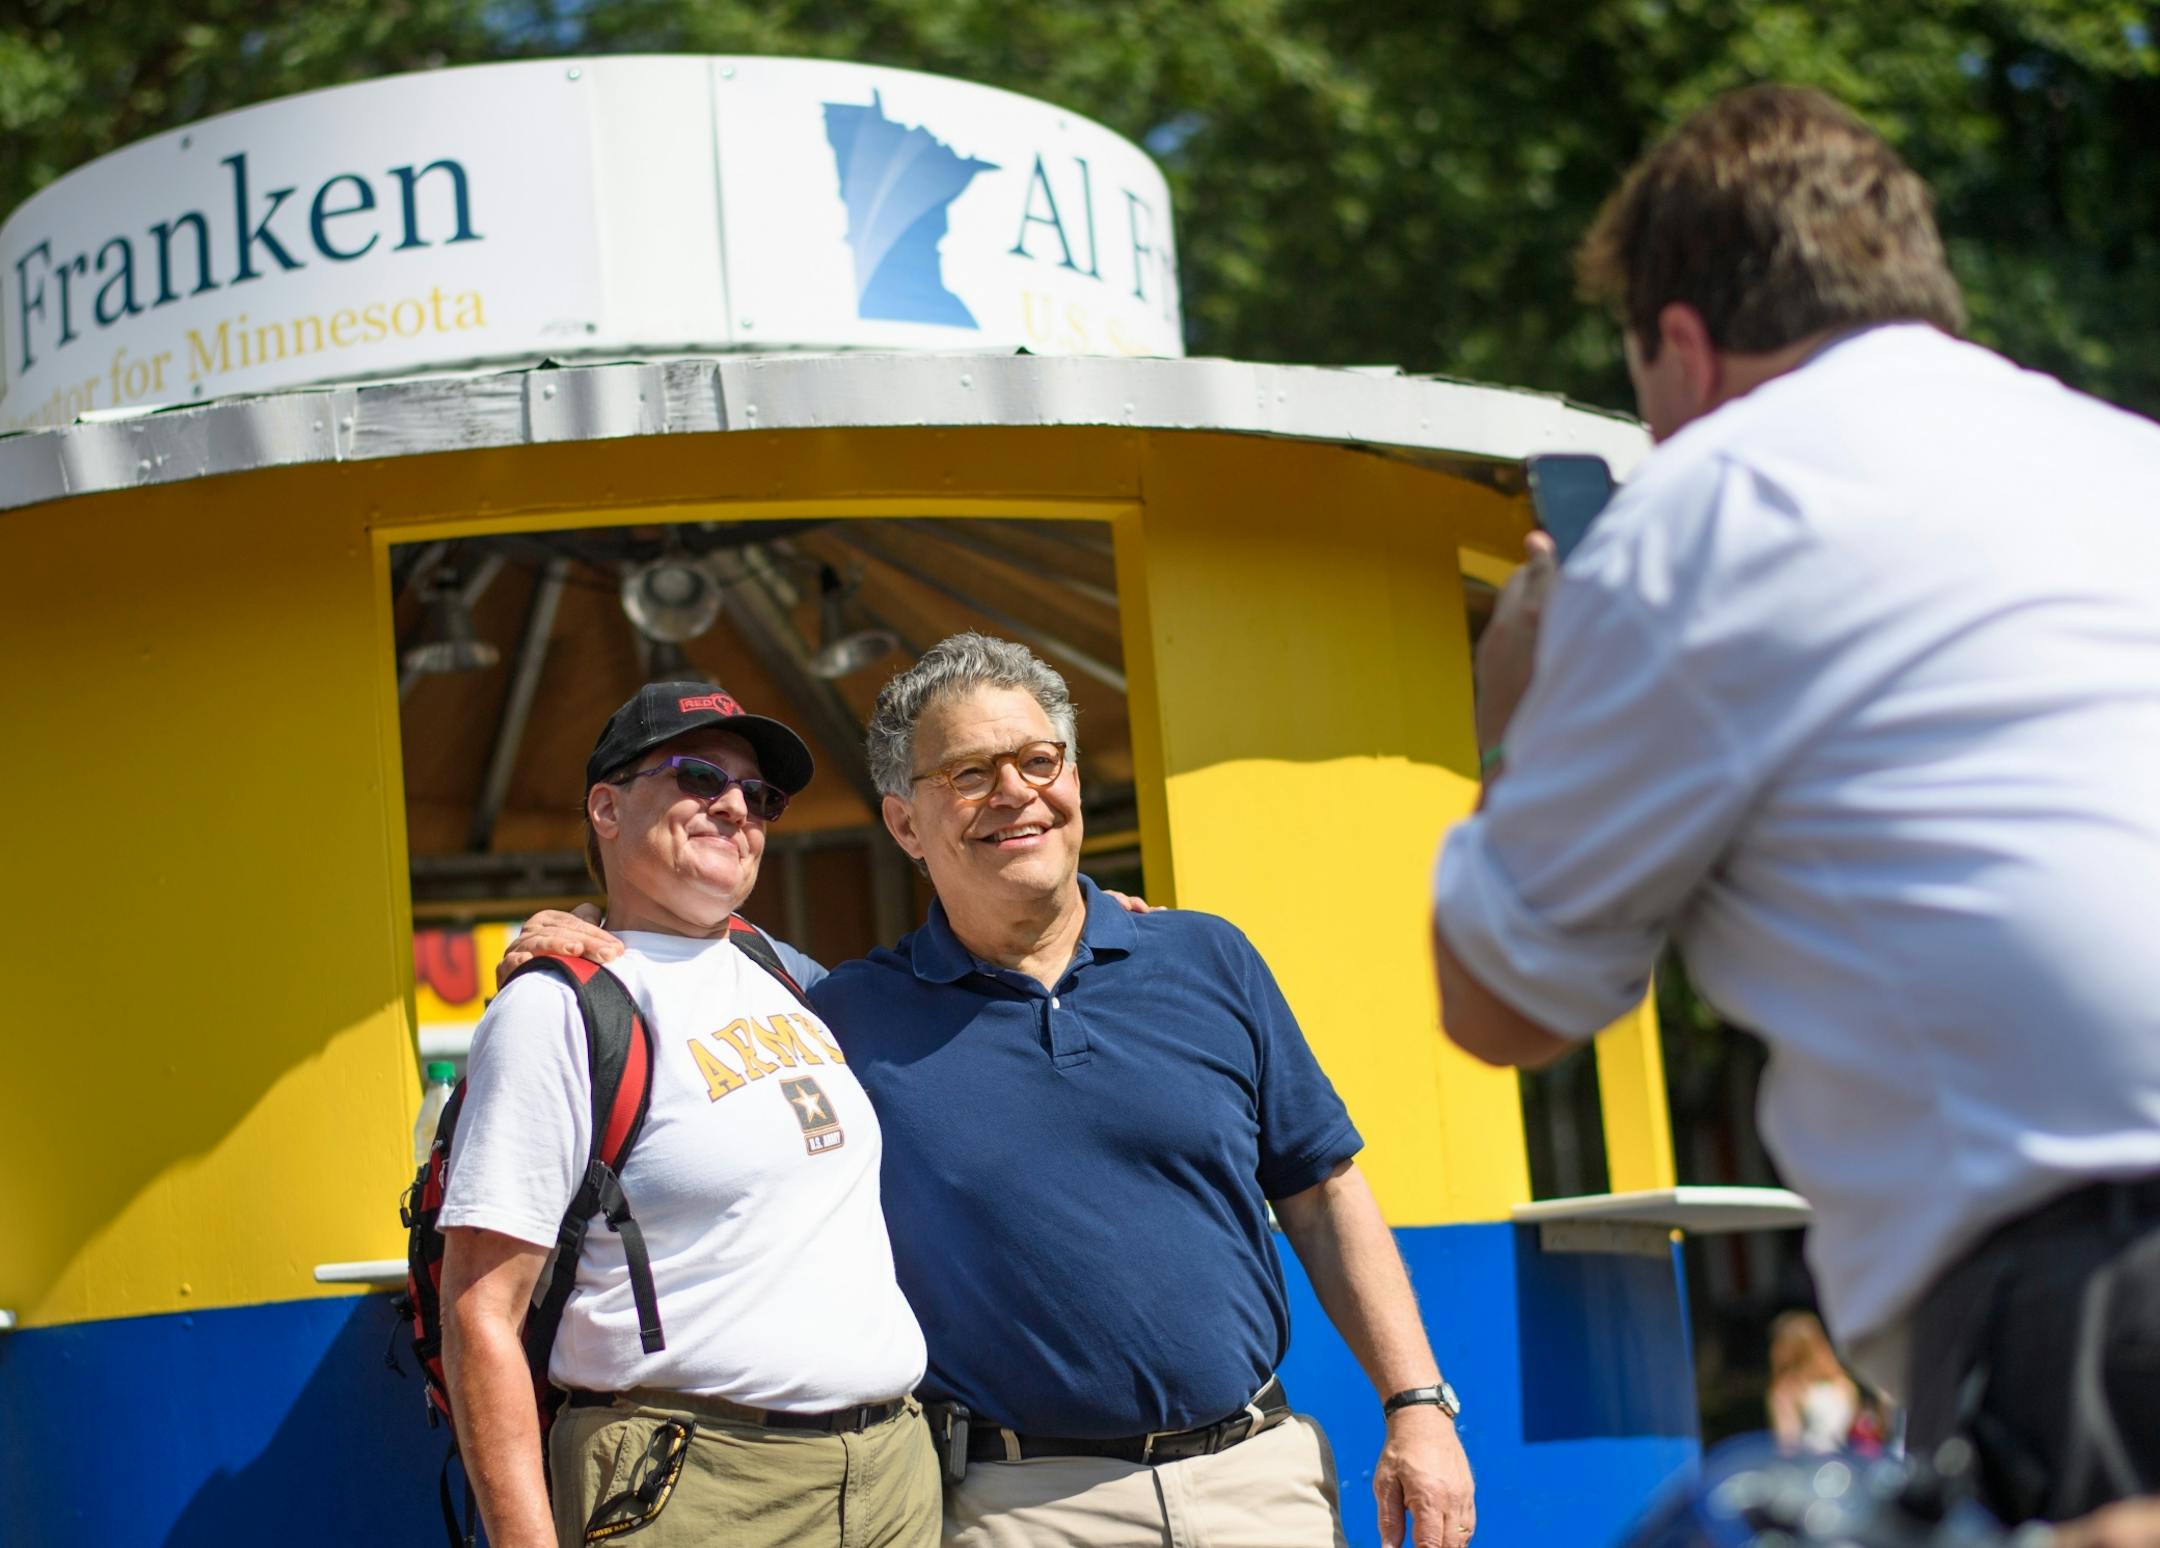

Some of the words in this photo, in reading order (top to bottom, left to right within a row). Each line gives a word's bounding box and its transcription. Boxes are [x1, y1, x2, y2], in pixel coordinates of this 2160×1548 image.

[14, 151, 485, 376] Franken
[1008, 152, 1102, 281] Al
[109, 346, 173, 405] for
[185, 285, 486, 380] Minnesota
[687, 1013, 846, 1103] ARMY
